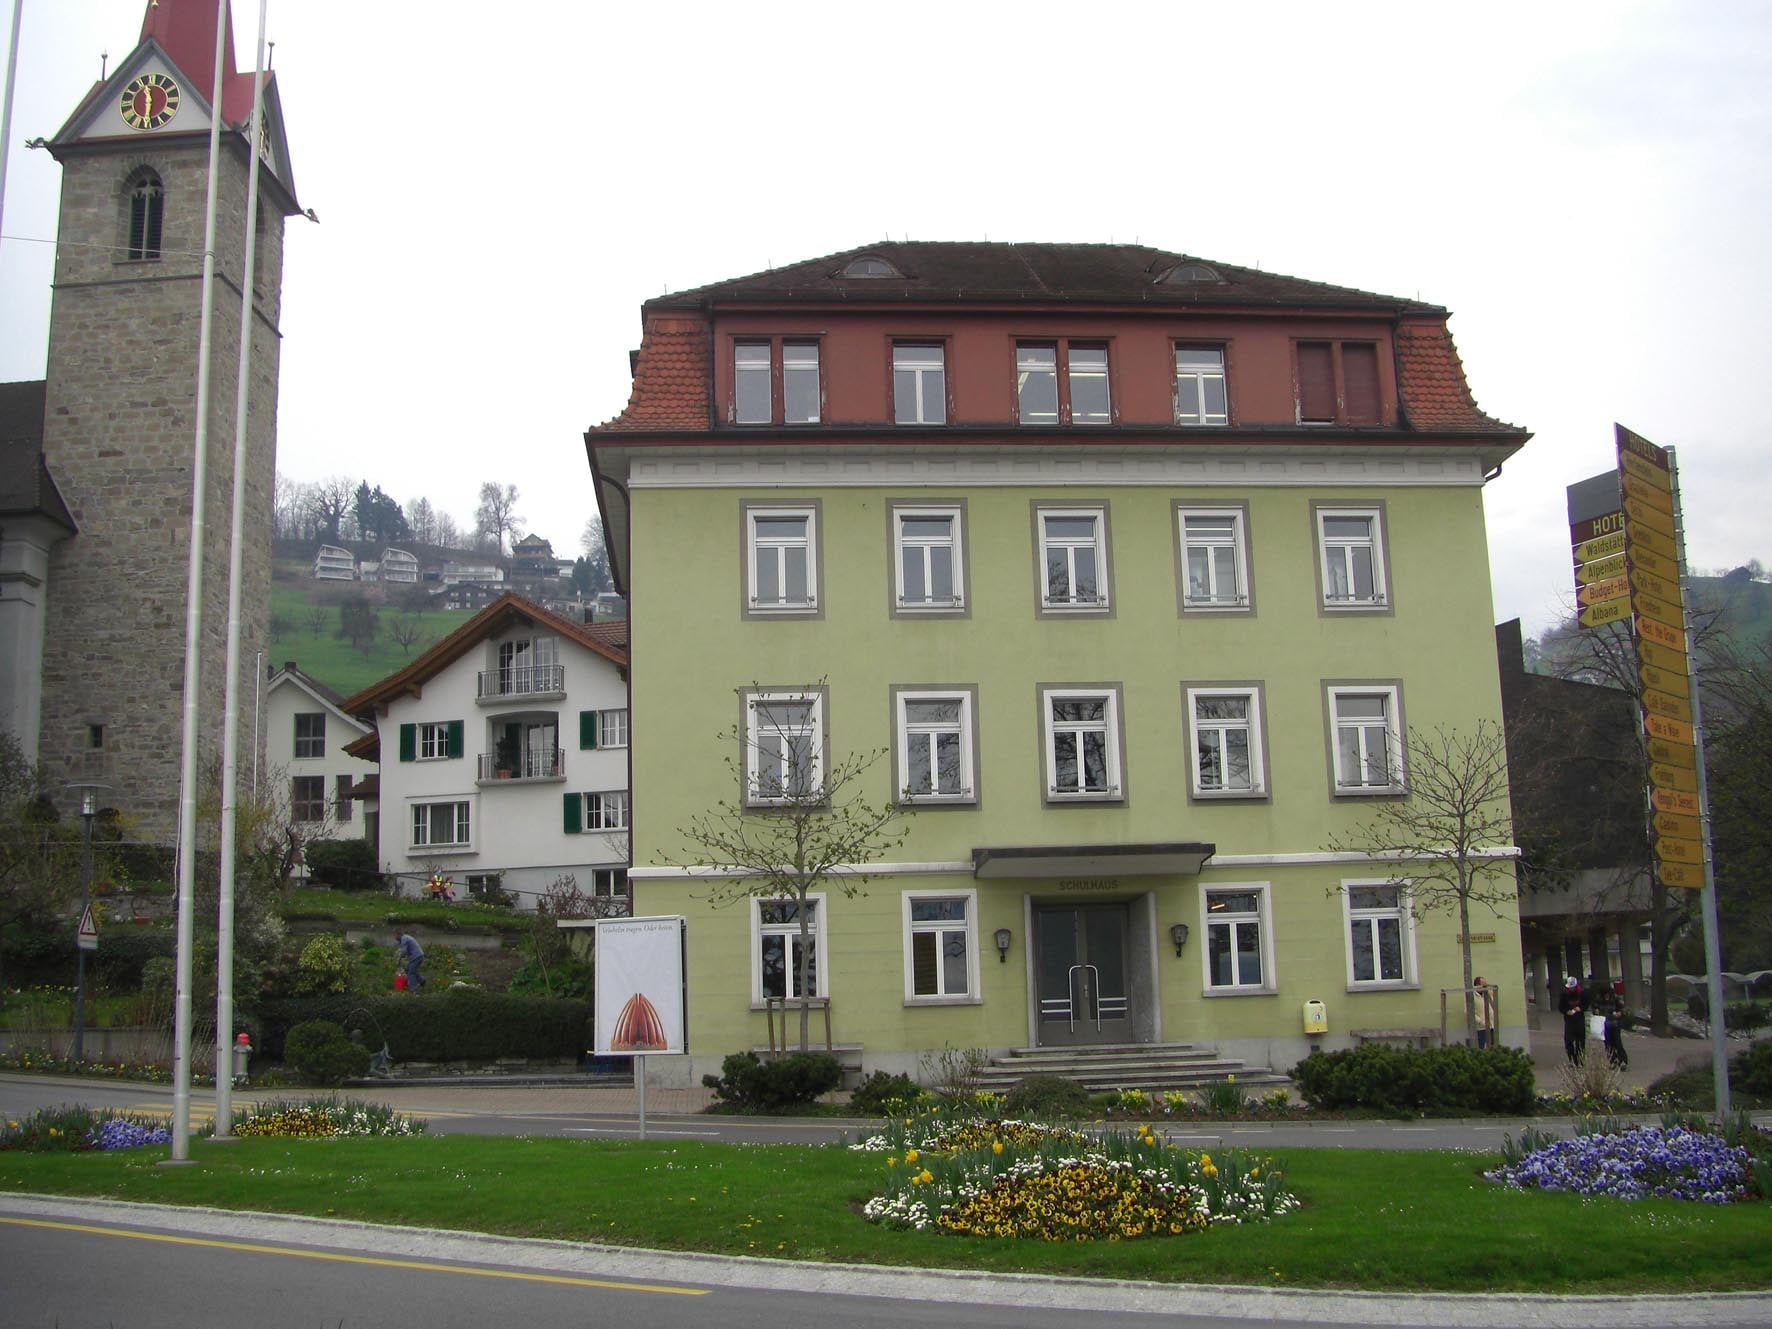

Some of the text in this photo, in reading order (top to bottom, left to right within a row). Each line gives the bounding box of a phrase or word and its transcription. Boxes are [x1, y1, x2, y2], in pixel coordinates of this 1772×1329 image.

[1593, 511, 1624, 536] HOTE
[1586, 535, 1624, 557] Waldstätt
[1589, 579, 1628, 599] Budget-Ho
[1592, 605, 1618, 621] Albana
[1058, 879, 1119, 891] SCHULHAUS
